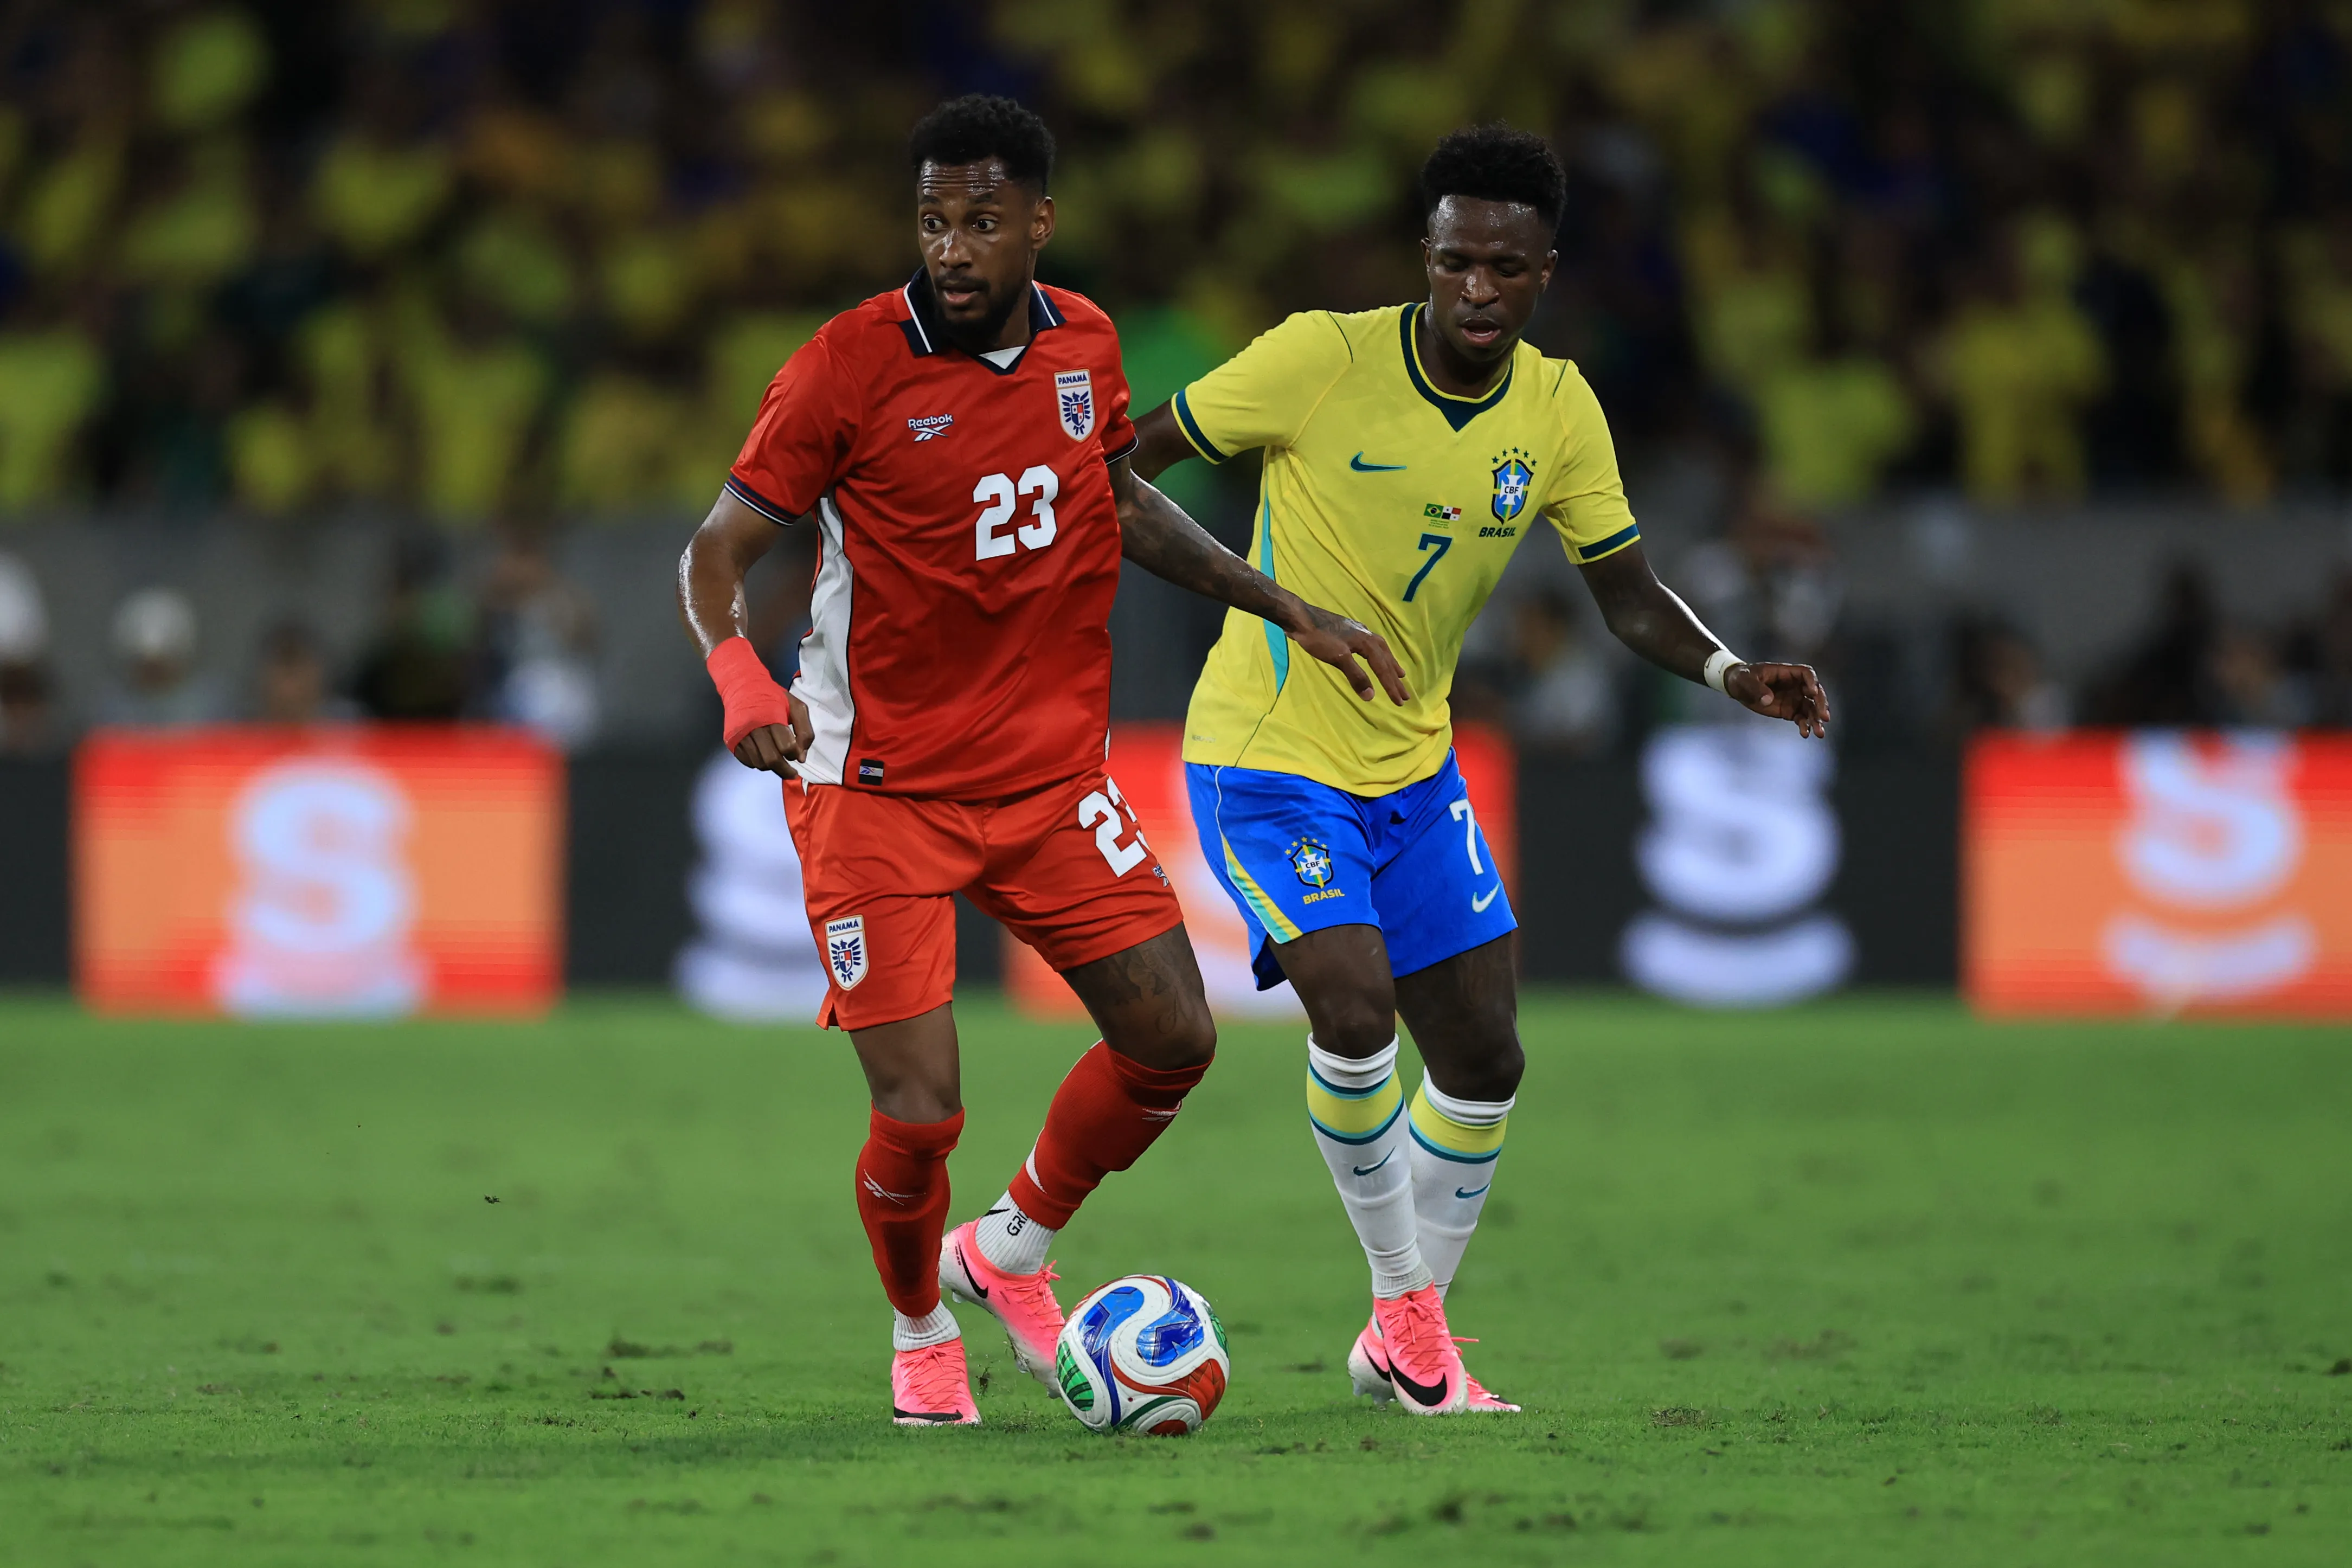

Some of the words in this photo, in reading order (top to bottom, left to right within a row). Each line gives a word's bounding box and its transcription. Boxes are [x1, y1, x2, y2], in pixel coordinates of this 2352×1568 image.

[1058, 372, 1088, 385] PANAMÁ
[908, 414, 953, 429] Reebok
[1504, 486, 1520, 494] CBF
[973, 464, 1059, 561] 23
[1479, 526, 1516, 538] BRASIL
[1402, 532, 1454, 602] 7
[1449, 799, 1484, 876] 7
[1305, 860, 1320, 869] CBF
[1302, 888, 1345, 905] BRASIL
[828, 918, 859, 933] PANAMÁ
[1007, 1208, 1029, 1236] GRI
